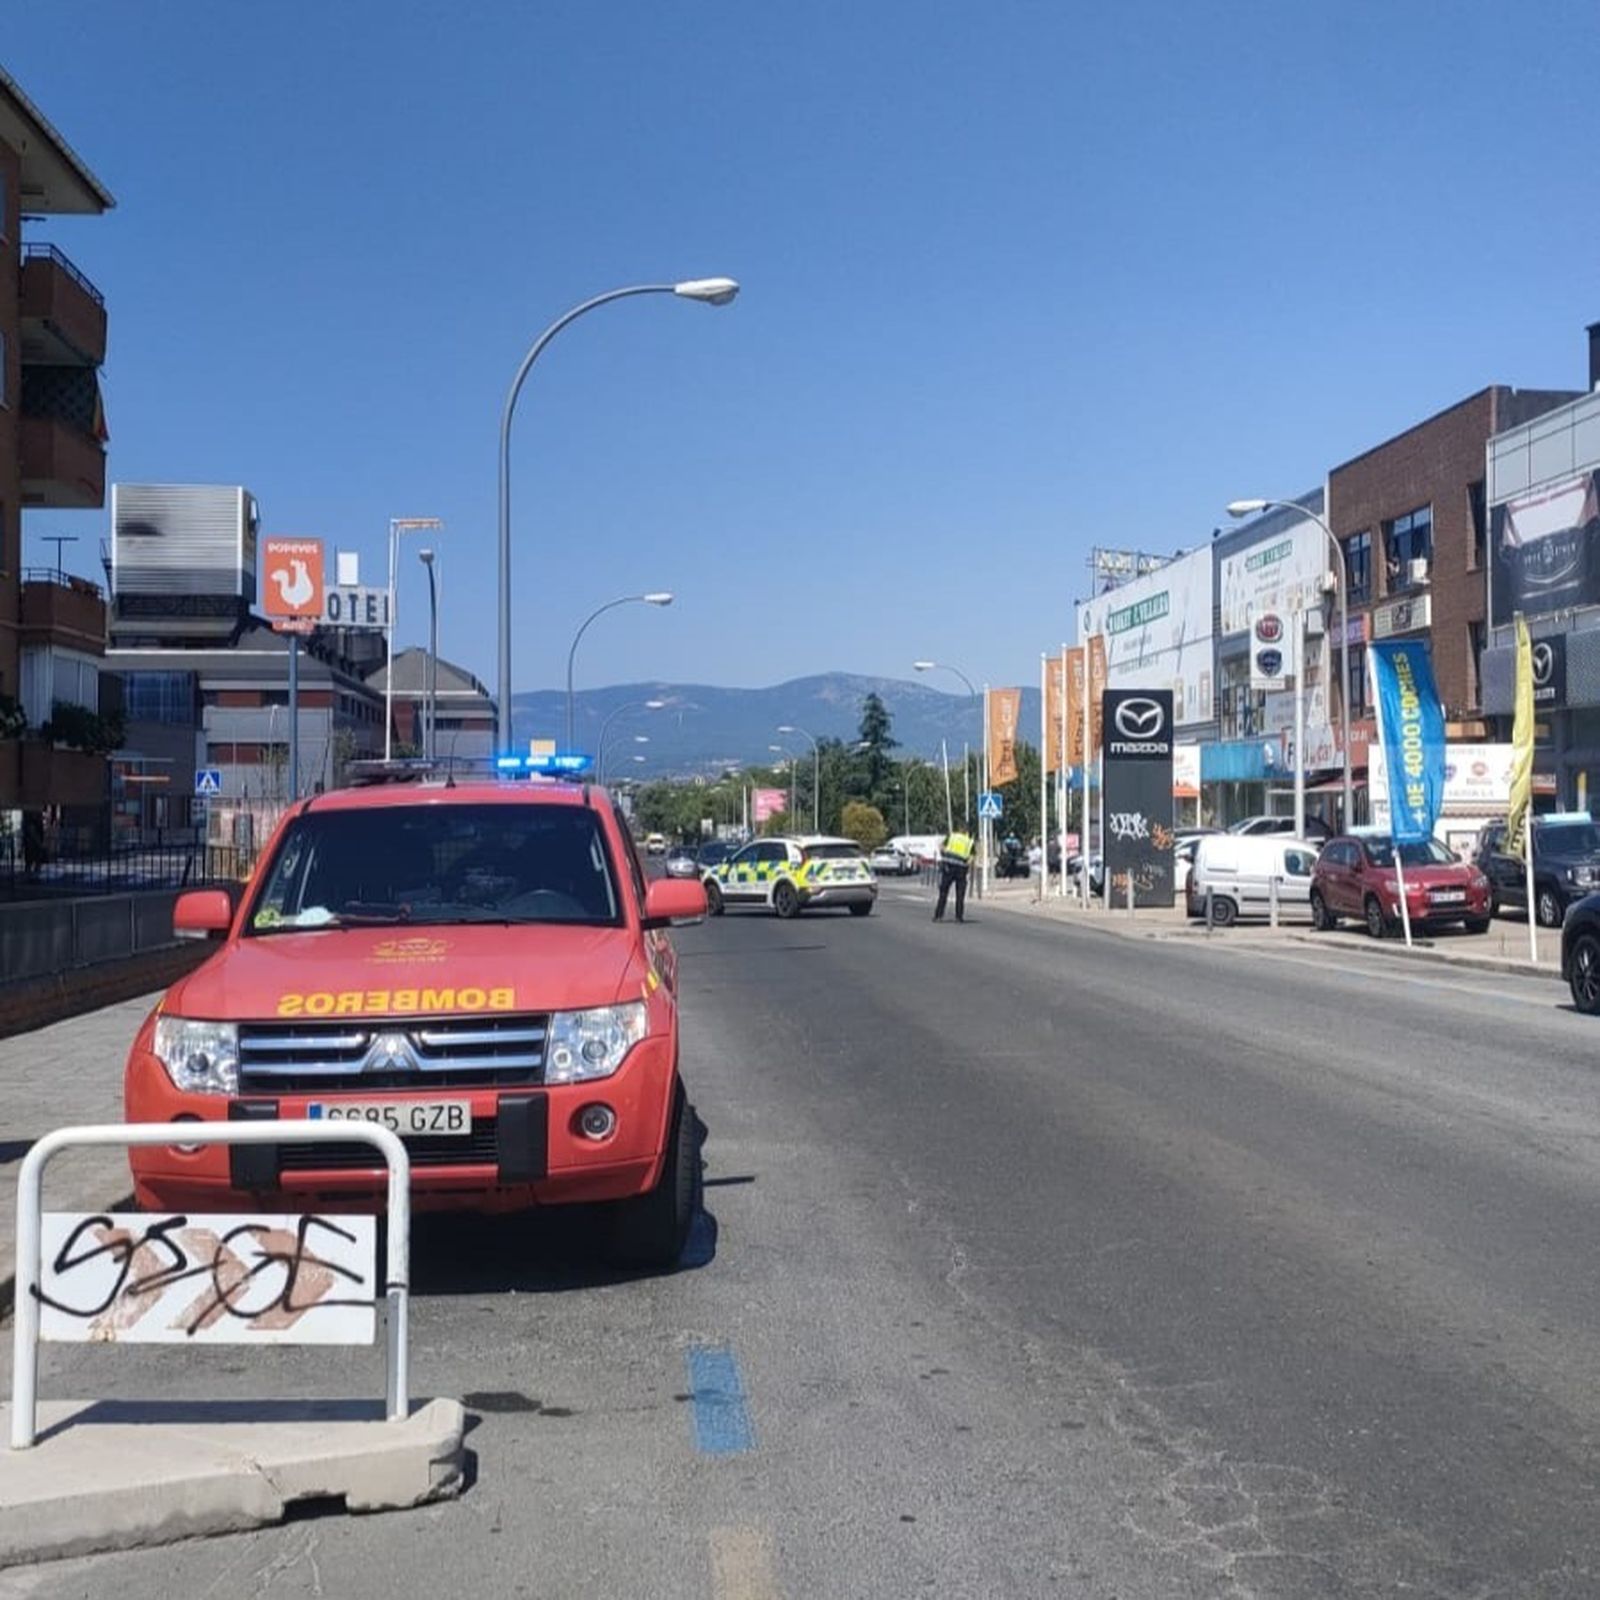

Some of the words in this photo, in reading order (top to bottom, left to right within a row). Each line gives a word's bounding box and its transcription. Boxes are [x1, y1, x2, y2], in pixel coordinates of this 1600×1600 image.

[1392, 652, 1420, 721] COCHES
[1401, 722, 1424, 778] 4000
[1407, 783, 1424, 807] DE
[410, 1105, 464, 1132] GZB
